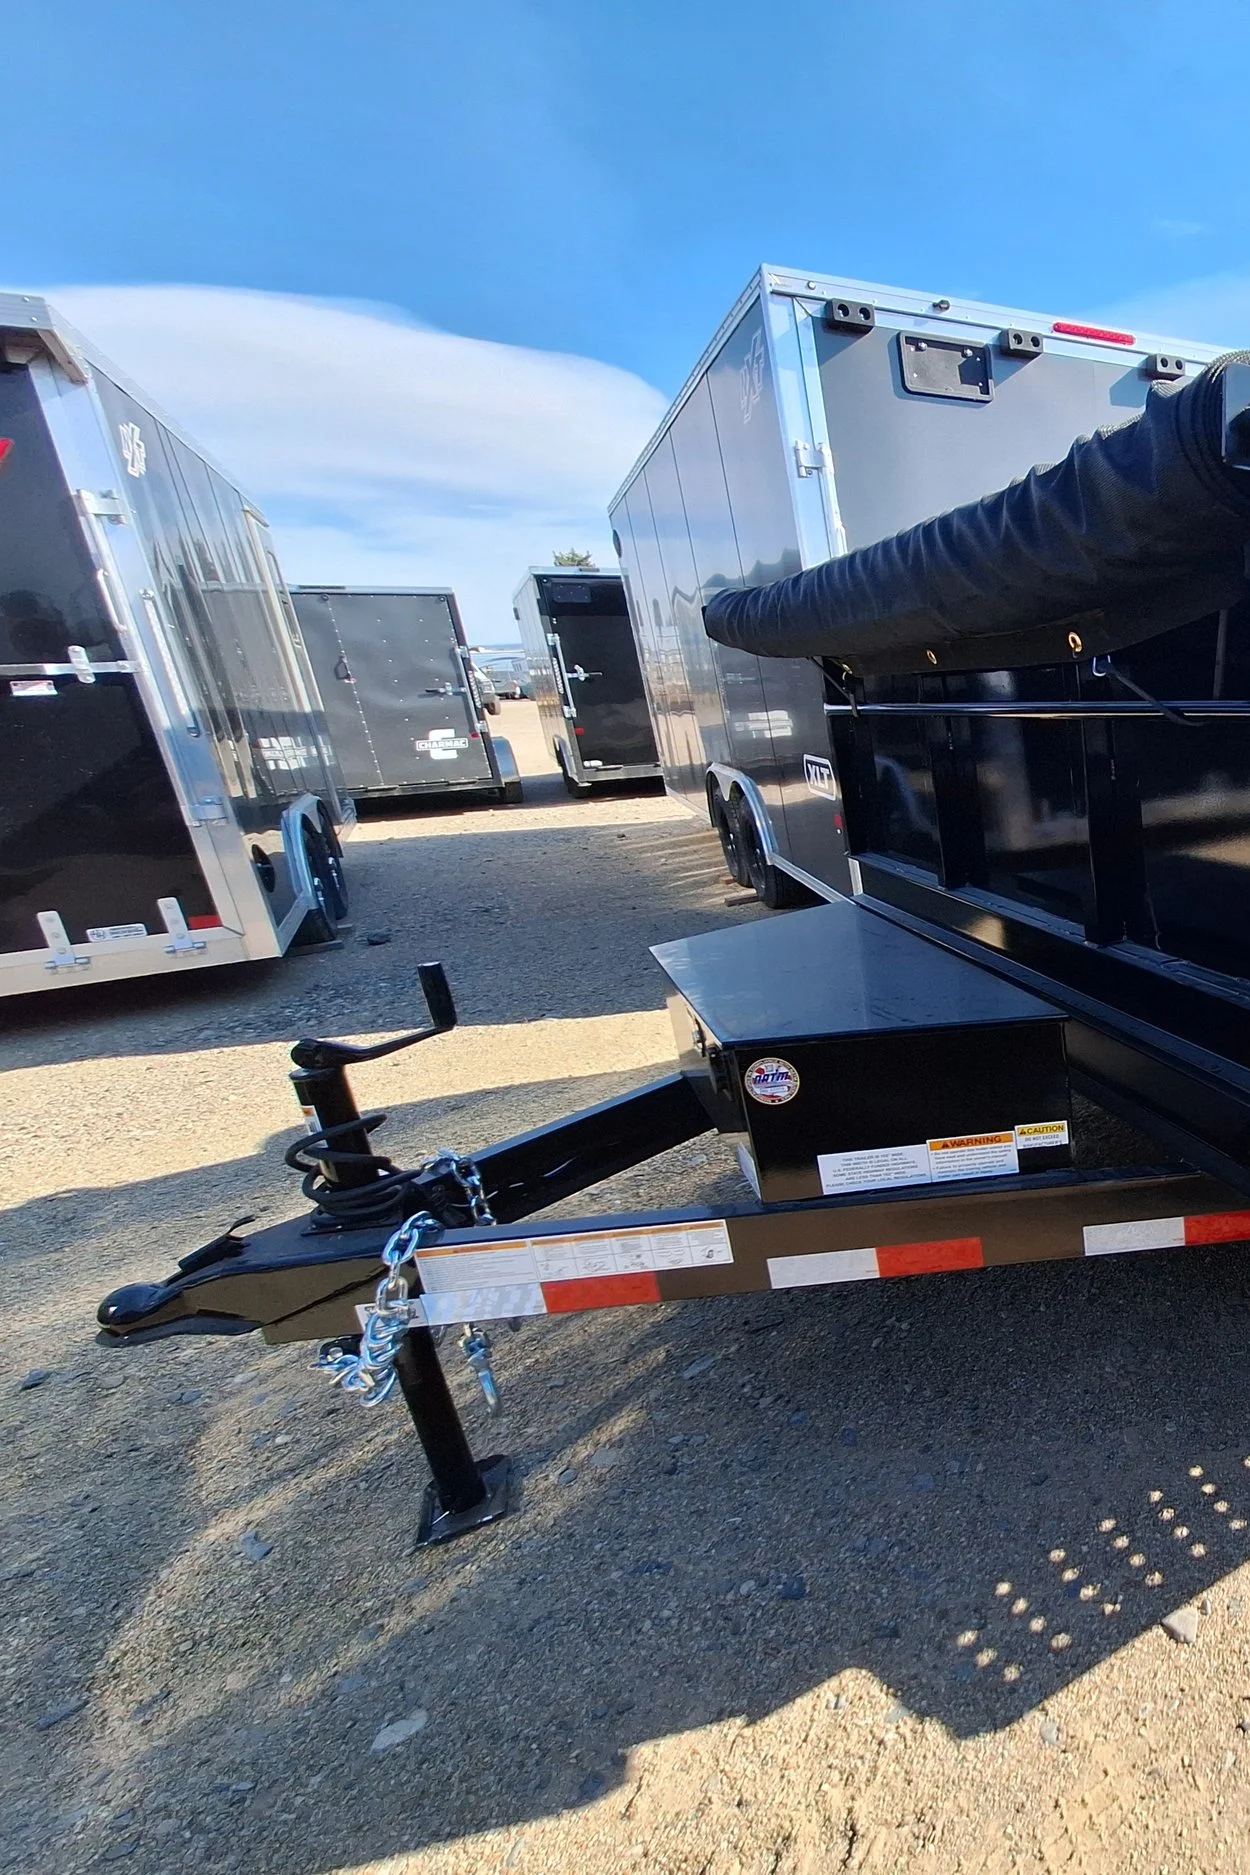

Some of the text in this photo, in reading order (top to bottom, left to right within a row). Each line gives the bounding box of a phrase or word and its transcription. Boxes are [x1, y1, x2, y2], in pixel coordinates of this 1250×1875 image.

[418, 741, 466, 749] CHARMAC
[807, 763, 830, 790] XLT
[1026, 1124, 1064, 1135] CAUTION
[950, 1135, 1002, 1147] WARNING
